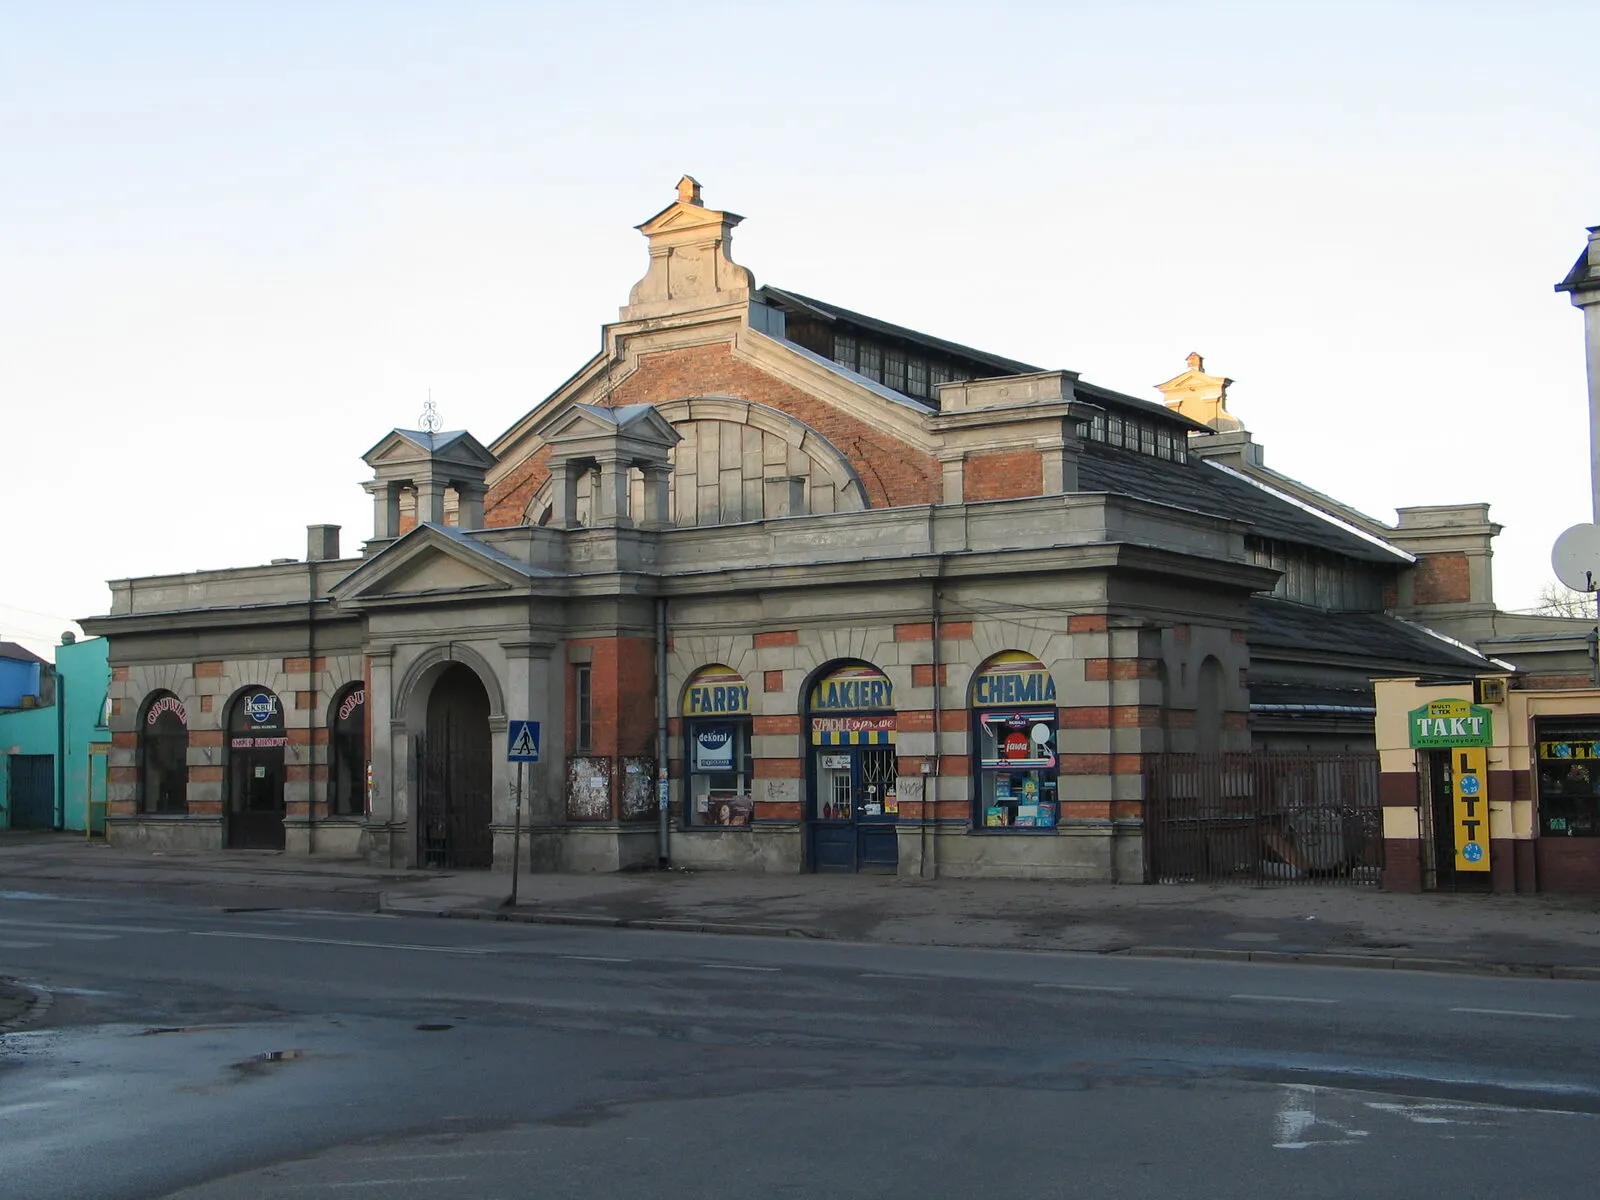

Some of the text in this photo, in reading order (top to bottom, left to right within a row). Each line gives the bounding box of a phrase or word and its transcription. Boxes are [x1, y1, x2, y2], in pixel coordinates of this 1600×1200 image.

[691, 686, 749, 713] FARBY
[816, 681, 893, 708] LAKIERY
[976, 674, 1057, 703] CHEMIA
[698, 731, 727, 742] dekoral
[1416, 717, 1483, 737] TAKT
[1006, 740, 1028, 753] jawa
